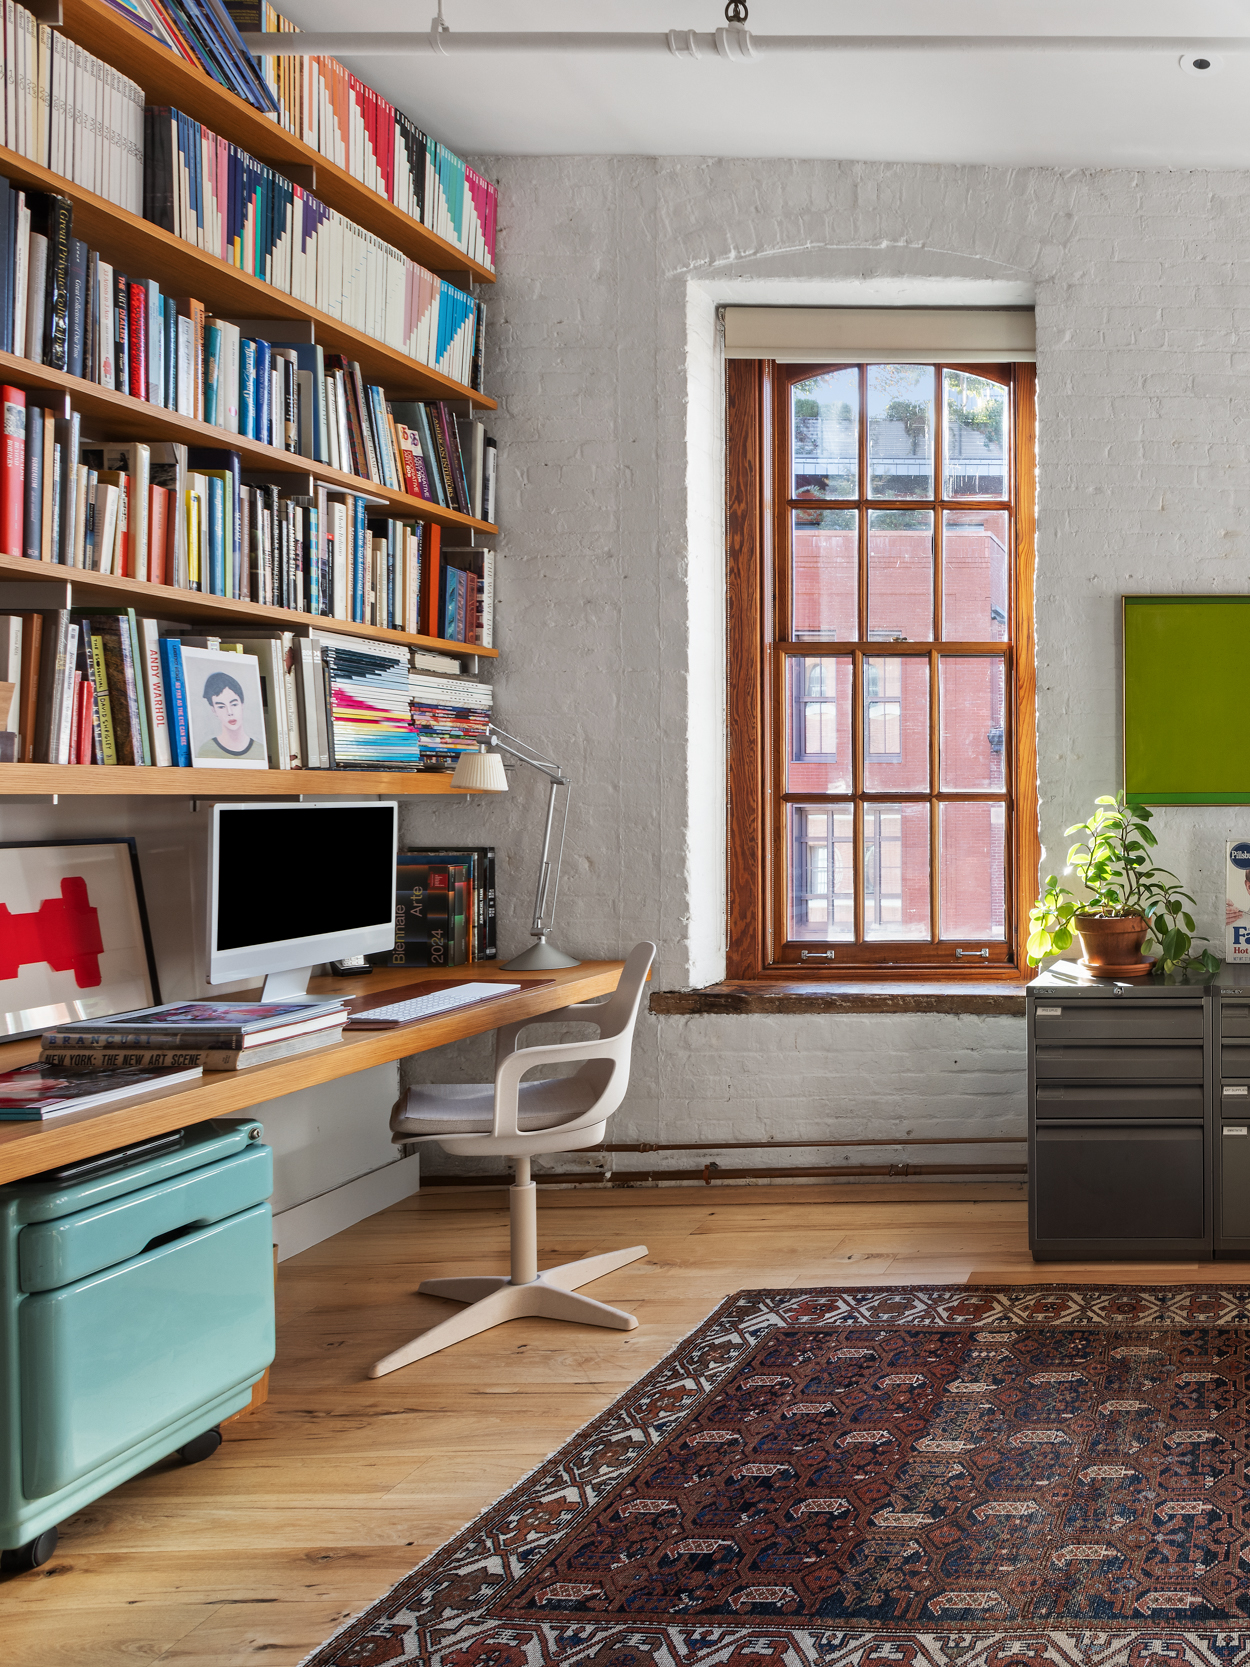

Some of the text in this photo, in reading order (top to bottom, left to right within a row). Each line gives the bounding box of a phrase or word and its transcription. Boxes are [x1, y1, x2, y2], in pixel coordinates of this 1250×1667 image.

[58, 209, 70, 243] Great
[118, 276, 126, 290] THE
[118, 291, 126, 308] ART
[135, 307, 143, 368] CONTEMPORARY
[487, 602, 492, 617] WE
[149, 649, 165, 728] ANDY WARHOL
[99, 697, 112, 750] DAVID SHRIGLEY
[410, 886, 423, 917] Arte
[392, 904, 406, 964] Biennale
[431, 929, 444, 963] 2024
[1233, 946, 1249, 954] Hot
[49, 1035, 151, 1045] BRANCUSI
[45, 1053, 202, 1066] NEW YORK: THE NEW ART SCENE
